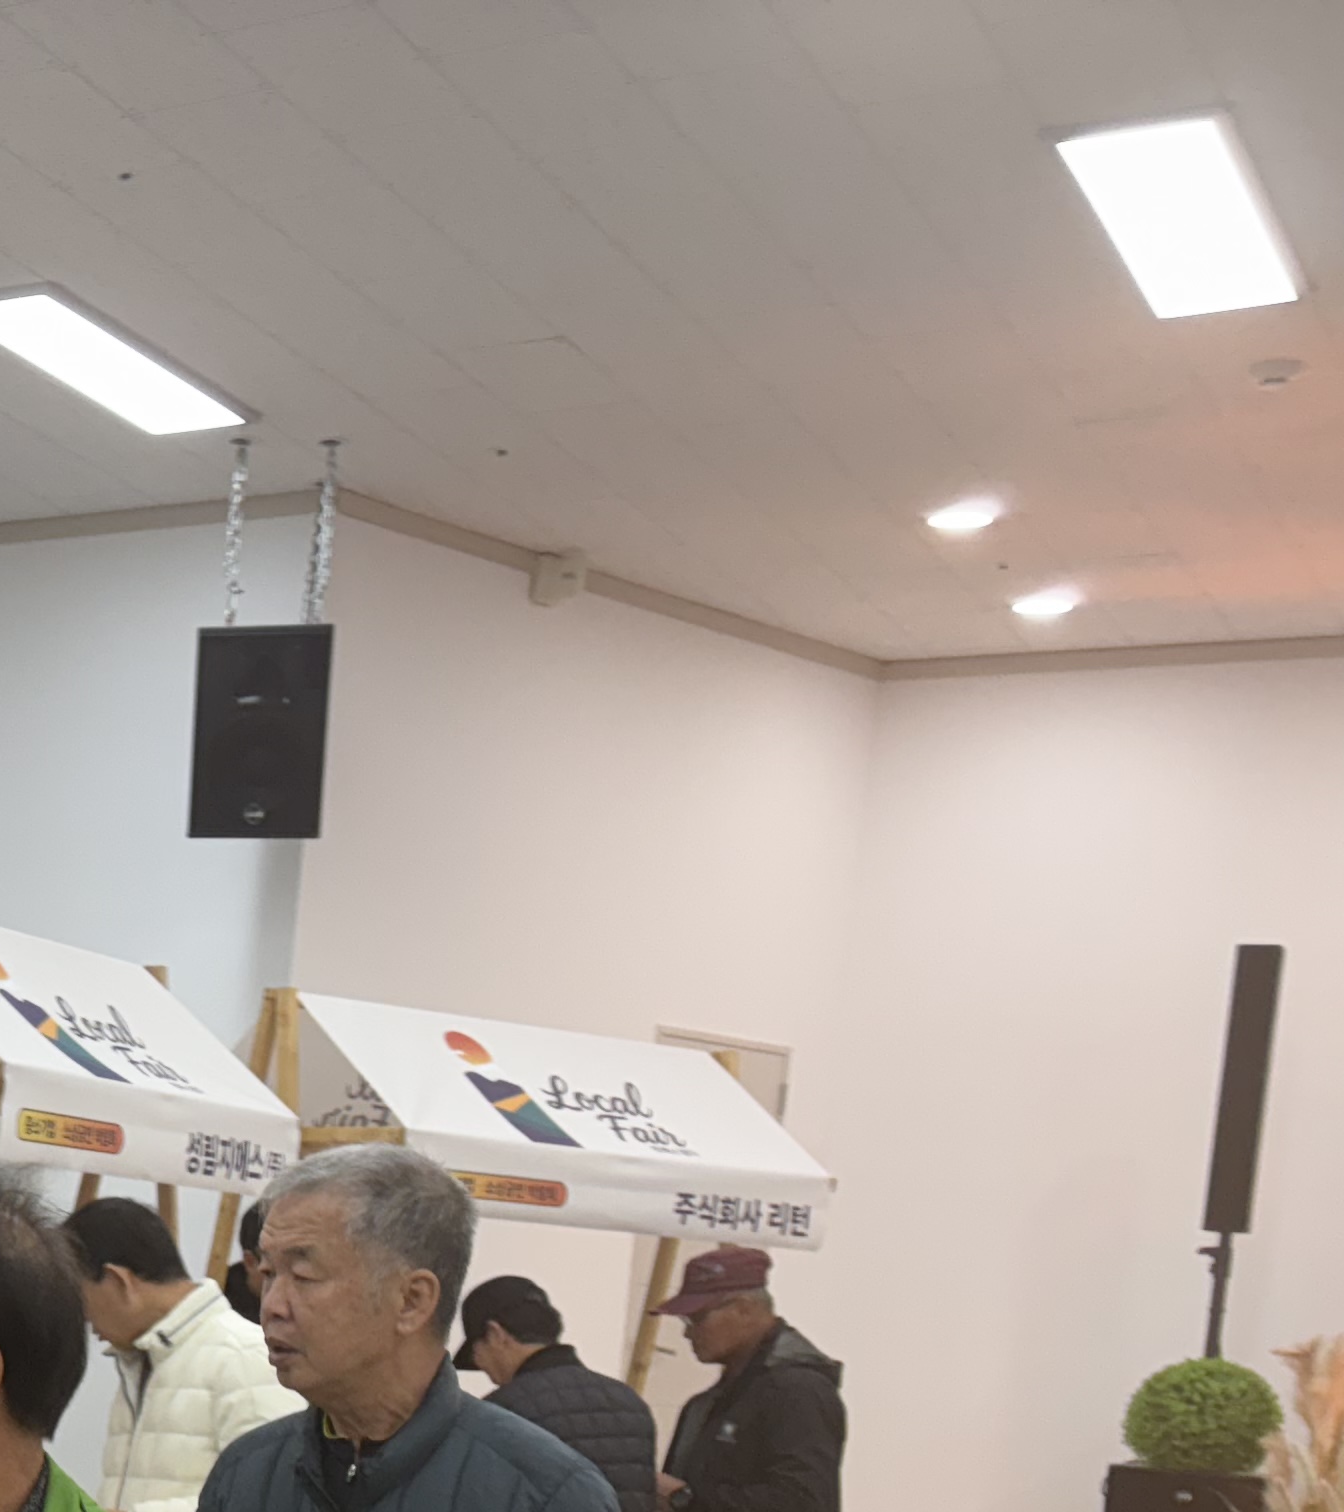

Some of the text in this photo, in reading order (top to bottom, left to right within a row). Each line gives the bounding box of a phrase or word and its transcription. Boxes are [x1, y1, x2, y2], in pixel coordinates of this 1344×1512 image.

[55, 994, 147, 1050] Local
[110, 1045, 189, 1084] Fair
[538, 1074, 653, 1119] Local
[596, 1113, 687, 1147] Fair
[673, 1191, 813, 1239] 주식회사 리턴
